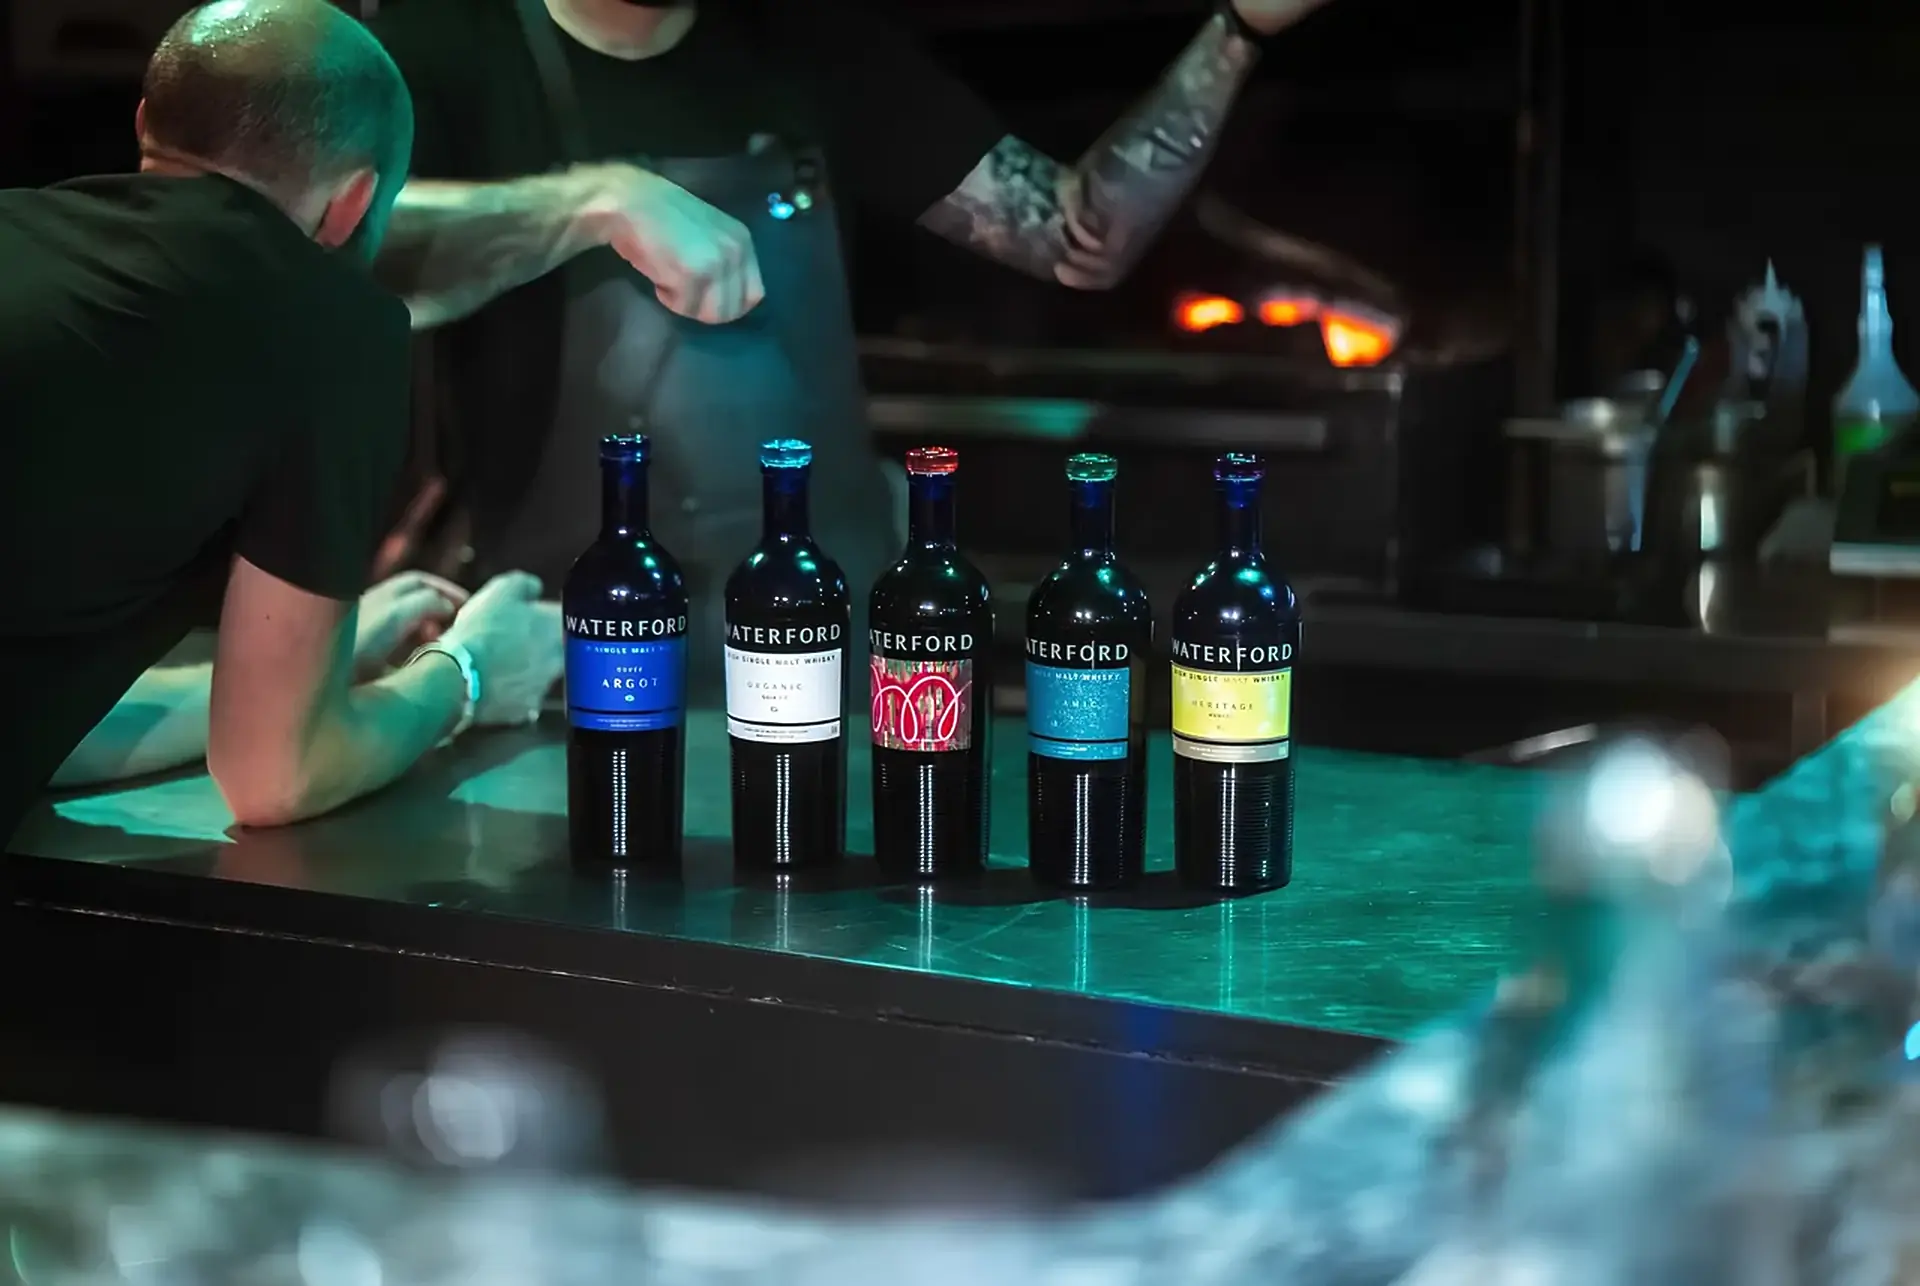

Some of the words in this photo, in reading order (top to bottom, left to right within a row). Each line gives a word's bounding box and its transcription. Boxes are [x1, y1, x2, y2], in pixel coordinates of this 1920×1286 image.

[566, 615, 686, 637] WATERFORD
[1171, 637, 1292, 663] WATERFORD
[742, 655, 770, 665] SINGLE
[775, 658, 800, 666] MALT
[804, 655, 835, 665] WHISKY
[602, 677, 658, 689] ARGOT
[1189, 674, 1218, 682] SINGLE
[1253, 674, 1285, 683] WHISKY
[746, 681, 802, 691] ORGANIC
[1192, 700, 1253, 711] HERITAGE
